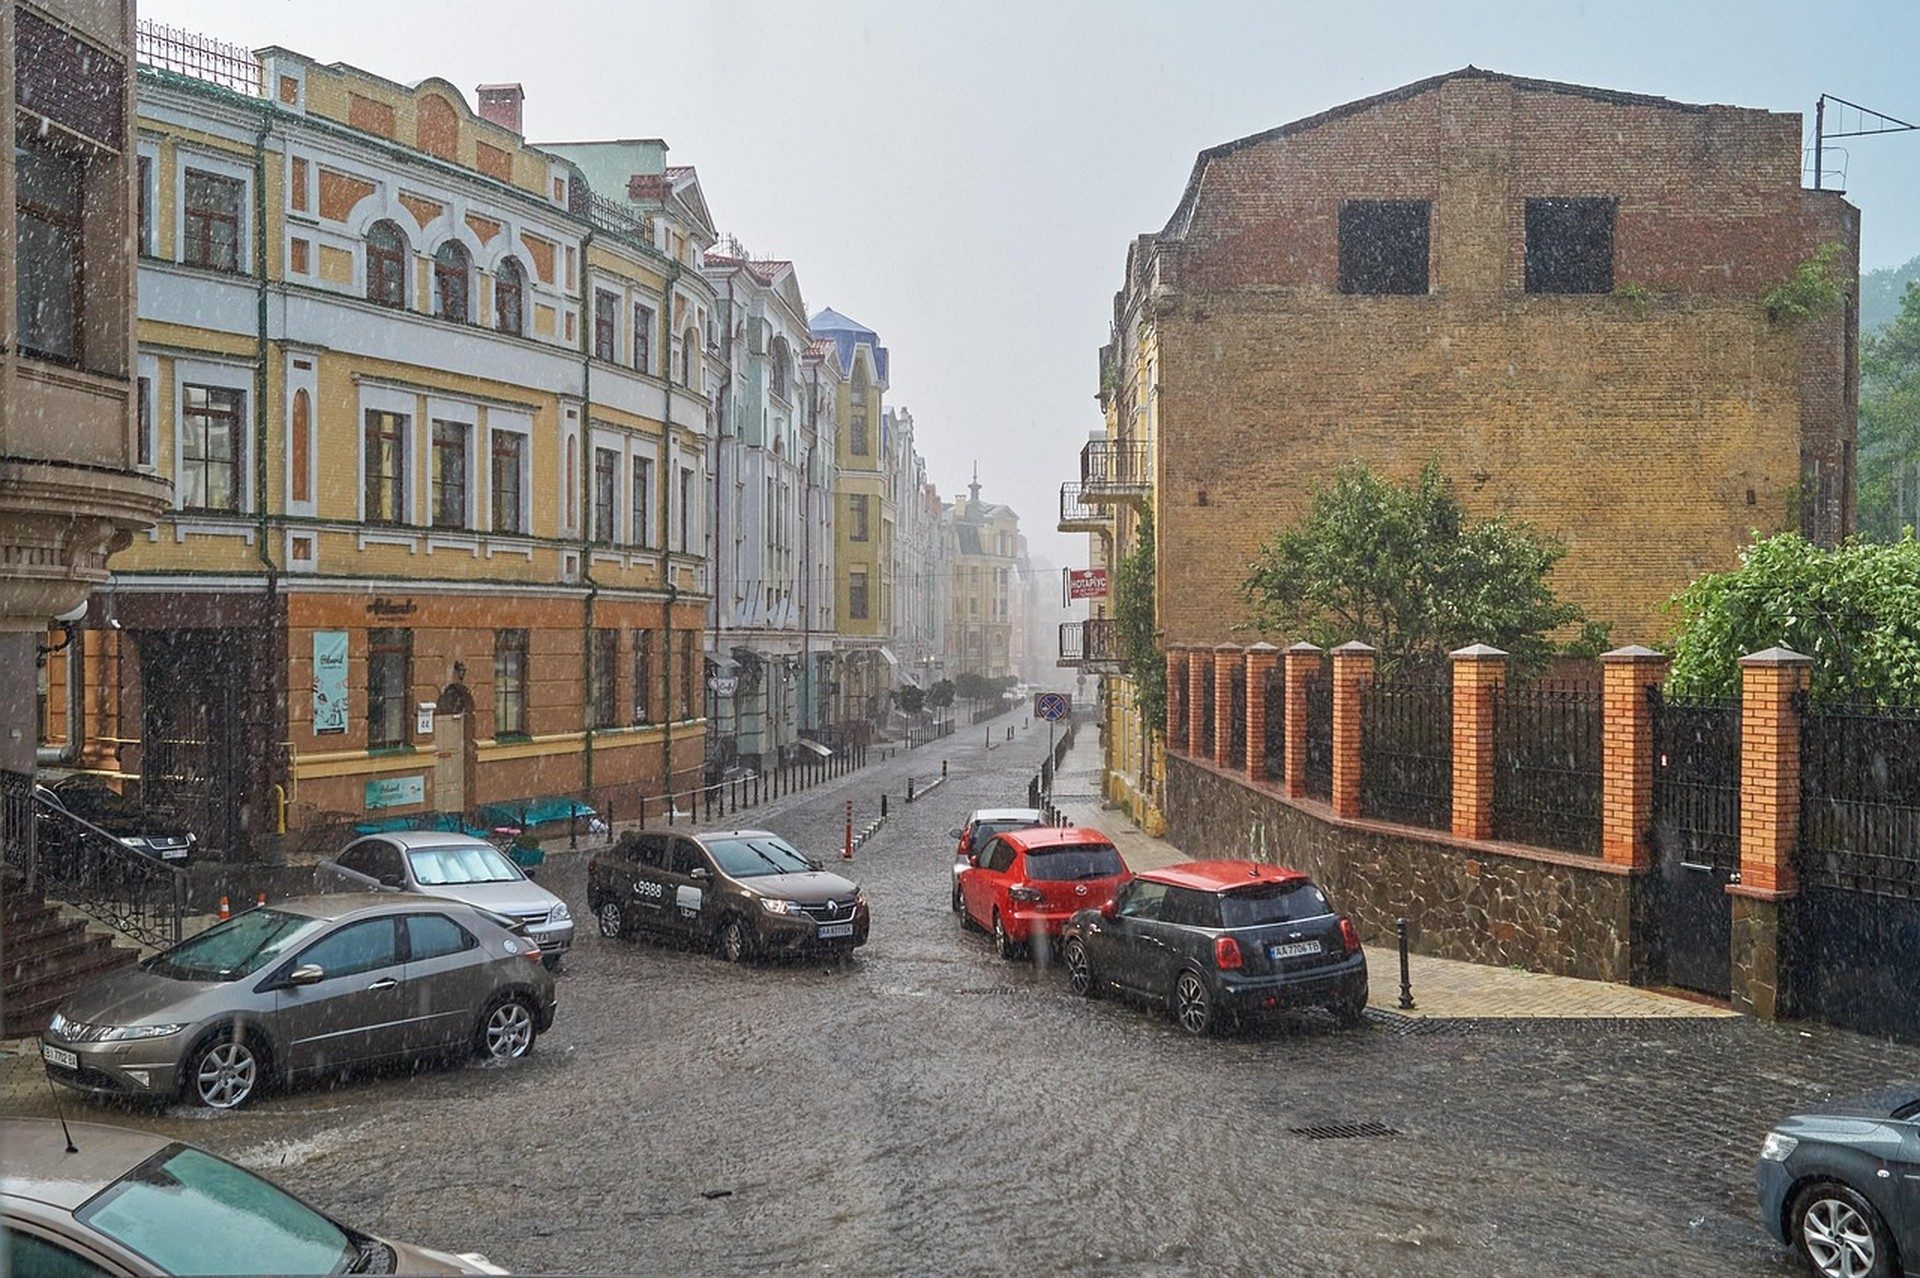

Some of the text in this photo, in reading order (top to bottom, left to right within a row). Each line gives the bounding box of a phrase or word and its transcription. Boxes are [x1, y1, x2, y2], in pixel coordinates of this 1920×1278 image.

[639, 881, 662, 897] 9988
[1276, 946, 1288, 956] AA
[1307, 941, 1319, 951] TB
